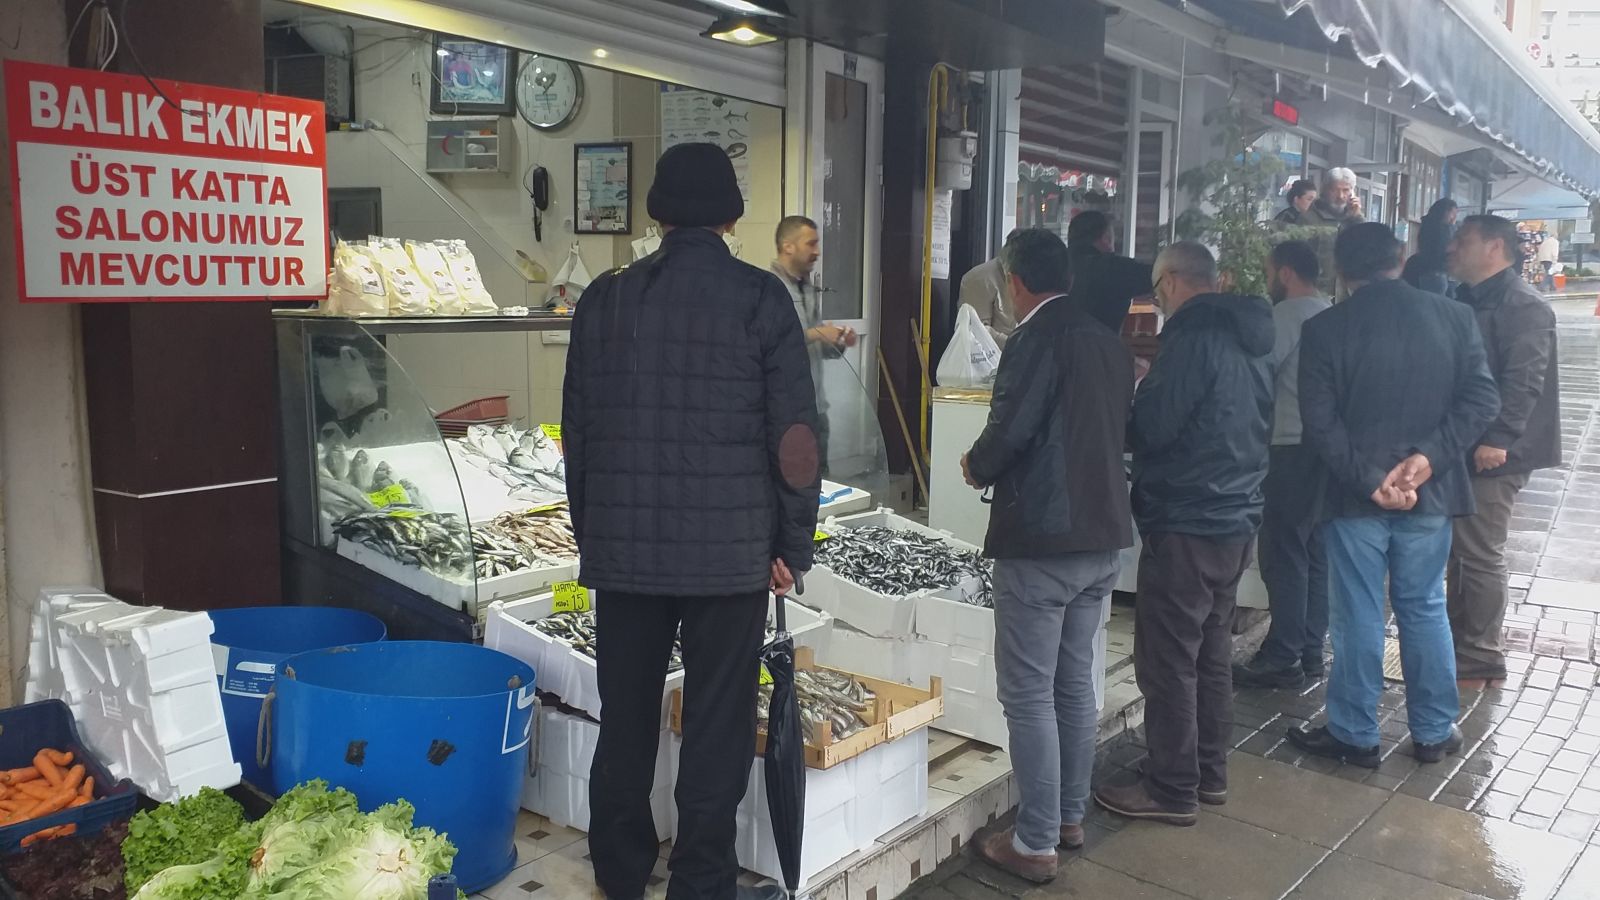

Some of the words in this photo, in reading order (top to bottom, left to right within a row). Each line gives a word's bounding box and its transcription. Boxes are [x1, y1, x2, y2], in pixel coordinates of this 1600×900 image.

[28, 80, 169, 140] BALIK
[180, 99, 313, 154] EKMEK
[71, 152, 156, 197] ÜST
[172, 168, 291, 206] KATTA
[55, 205, 305, 247] SALONUMUZ
[60, 252, 305, 286] MEVCUTTUR
[571, 593, 584, 610] 15
